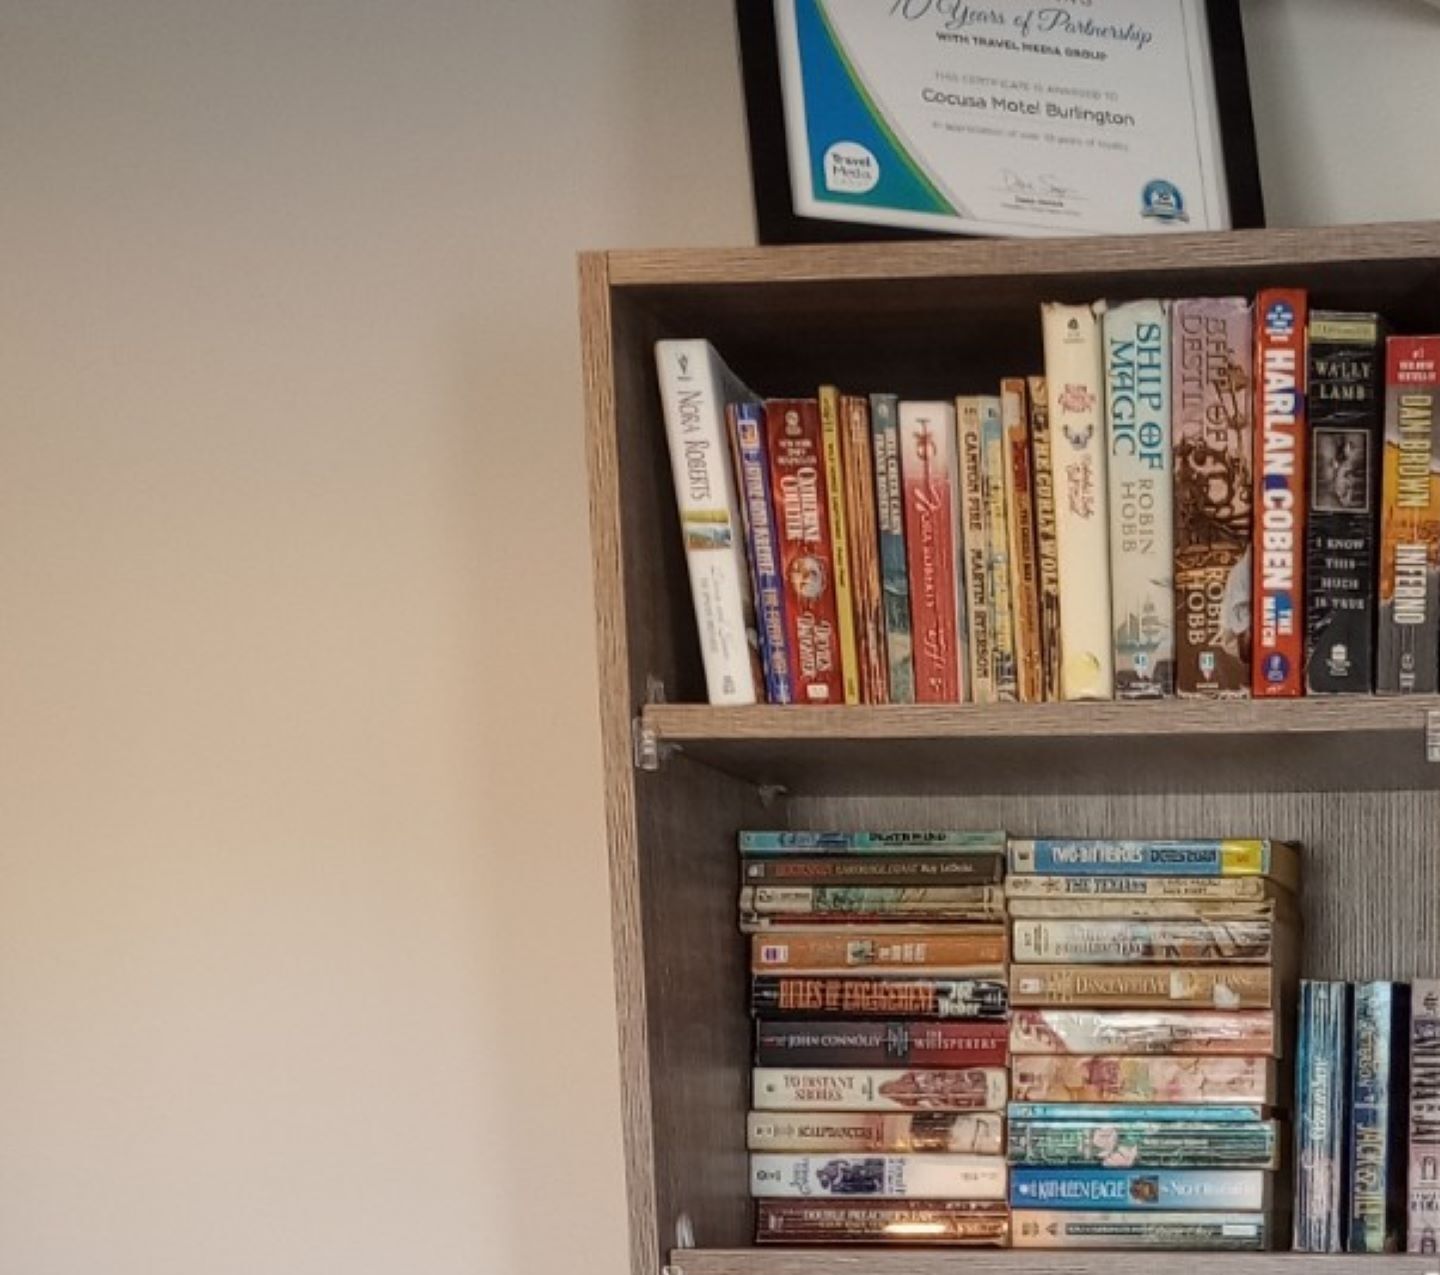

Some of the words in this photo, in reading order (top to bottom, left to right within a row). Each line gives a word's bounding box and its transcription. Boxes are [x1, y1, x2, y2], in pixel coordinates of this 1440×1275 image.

[1022, 42, 1061, 56] MEDIA
[1065, 47, 1108, 61] GROUP
[1038, 9, 1153, 50] Partnership
[921, 88, 988, 109] Cocusa
[993, 96, 1040, 114] Motel
[1046, 103, 1136, 126] Burlington
[1136, 323, 1163, 412] SHIP
[1314, 360, 1372, 378] WALLY
[1319, 384, 1366, 401] LAMB
[1109, 339, 1136, 457] MAGIC
[1264, 349, 1296, 476] HARLAN
[1400, 395, 1432, 436] DAN
[682, 440, 713, 500] ROBERTS
[1138, 420, 1164, 471] OF
[1397, 441, 1431, 508] BROWN
[1121, 481, 1138, 553] HOBB
[1137, 478, 1155, 556] ROBIN
[1262, 489, 1294, 591] COBEN
[1325, 557, 1356, 570] THIS
[1326, 538, 1365, 549] KNOW
[1187, 567, 1207, 646] HOBB
[1205, 564, 1228, 647] ROBIN
[1320, 576, 1360, 590] MUCH
[1394, 543, 1427, 625] INFERNO
[1261, 596, 1276, 648] MATCH
[789, 1035, 819, 1048] JOHN
[820, 1034, 881, 1047] CONNOLLY
